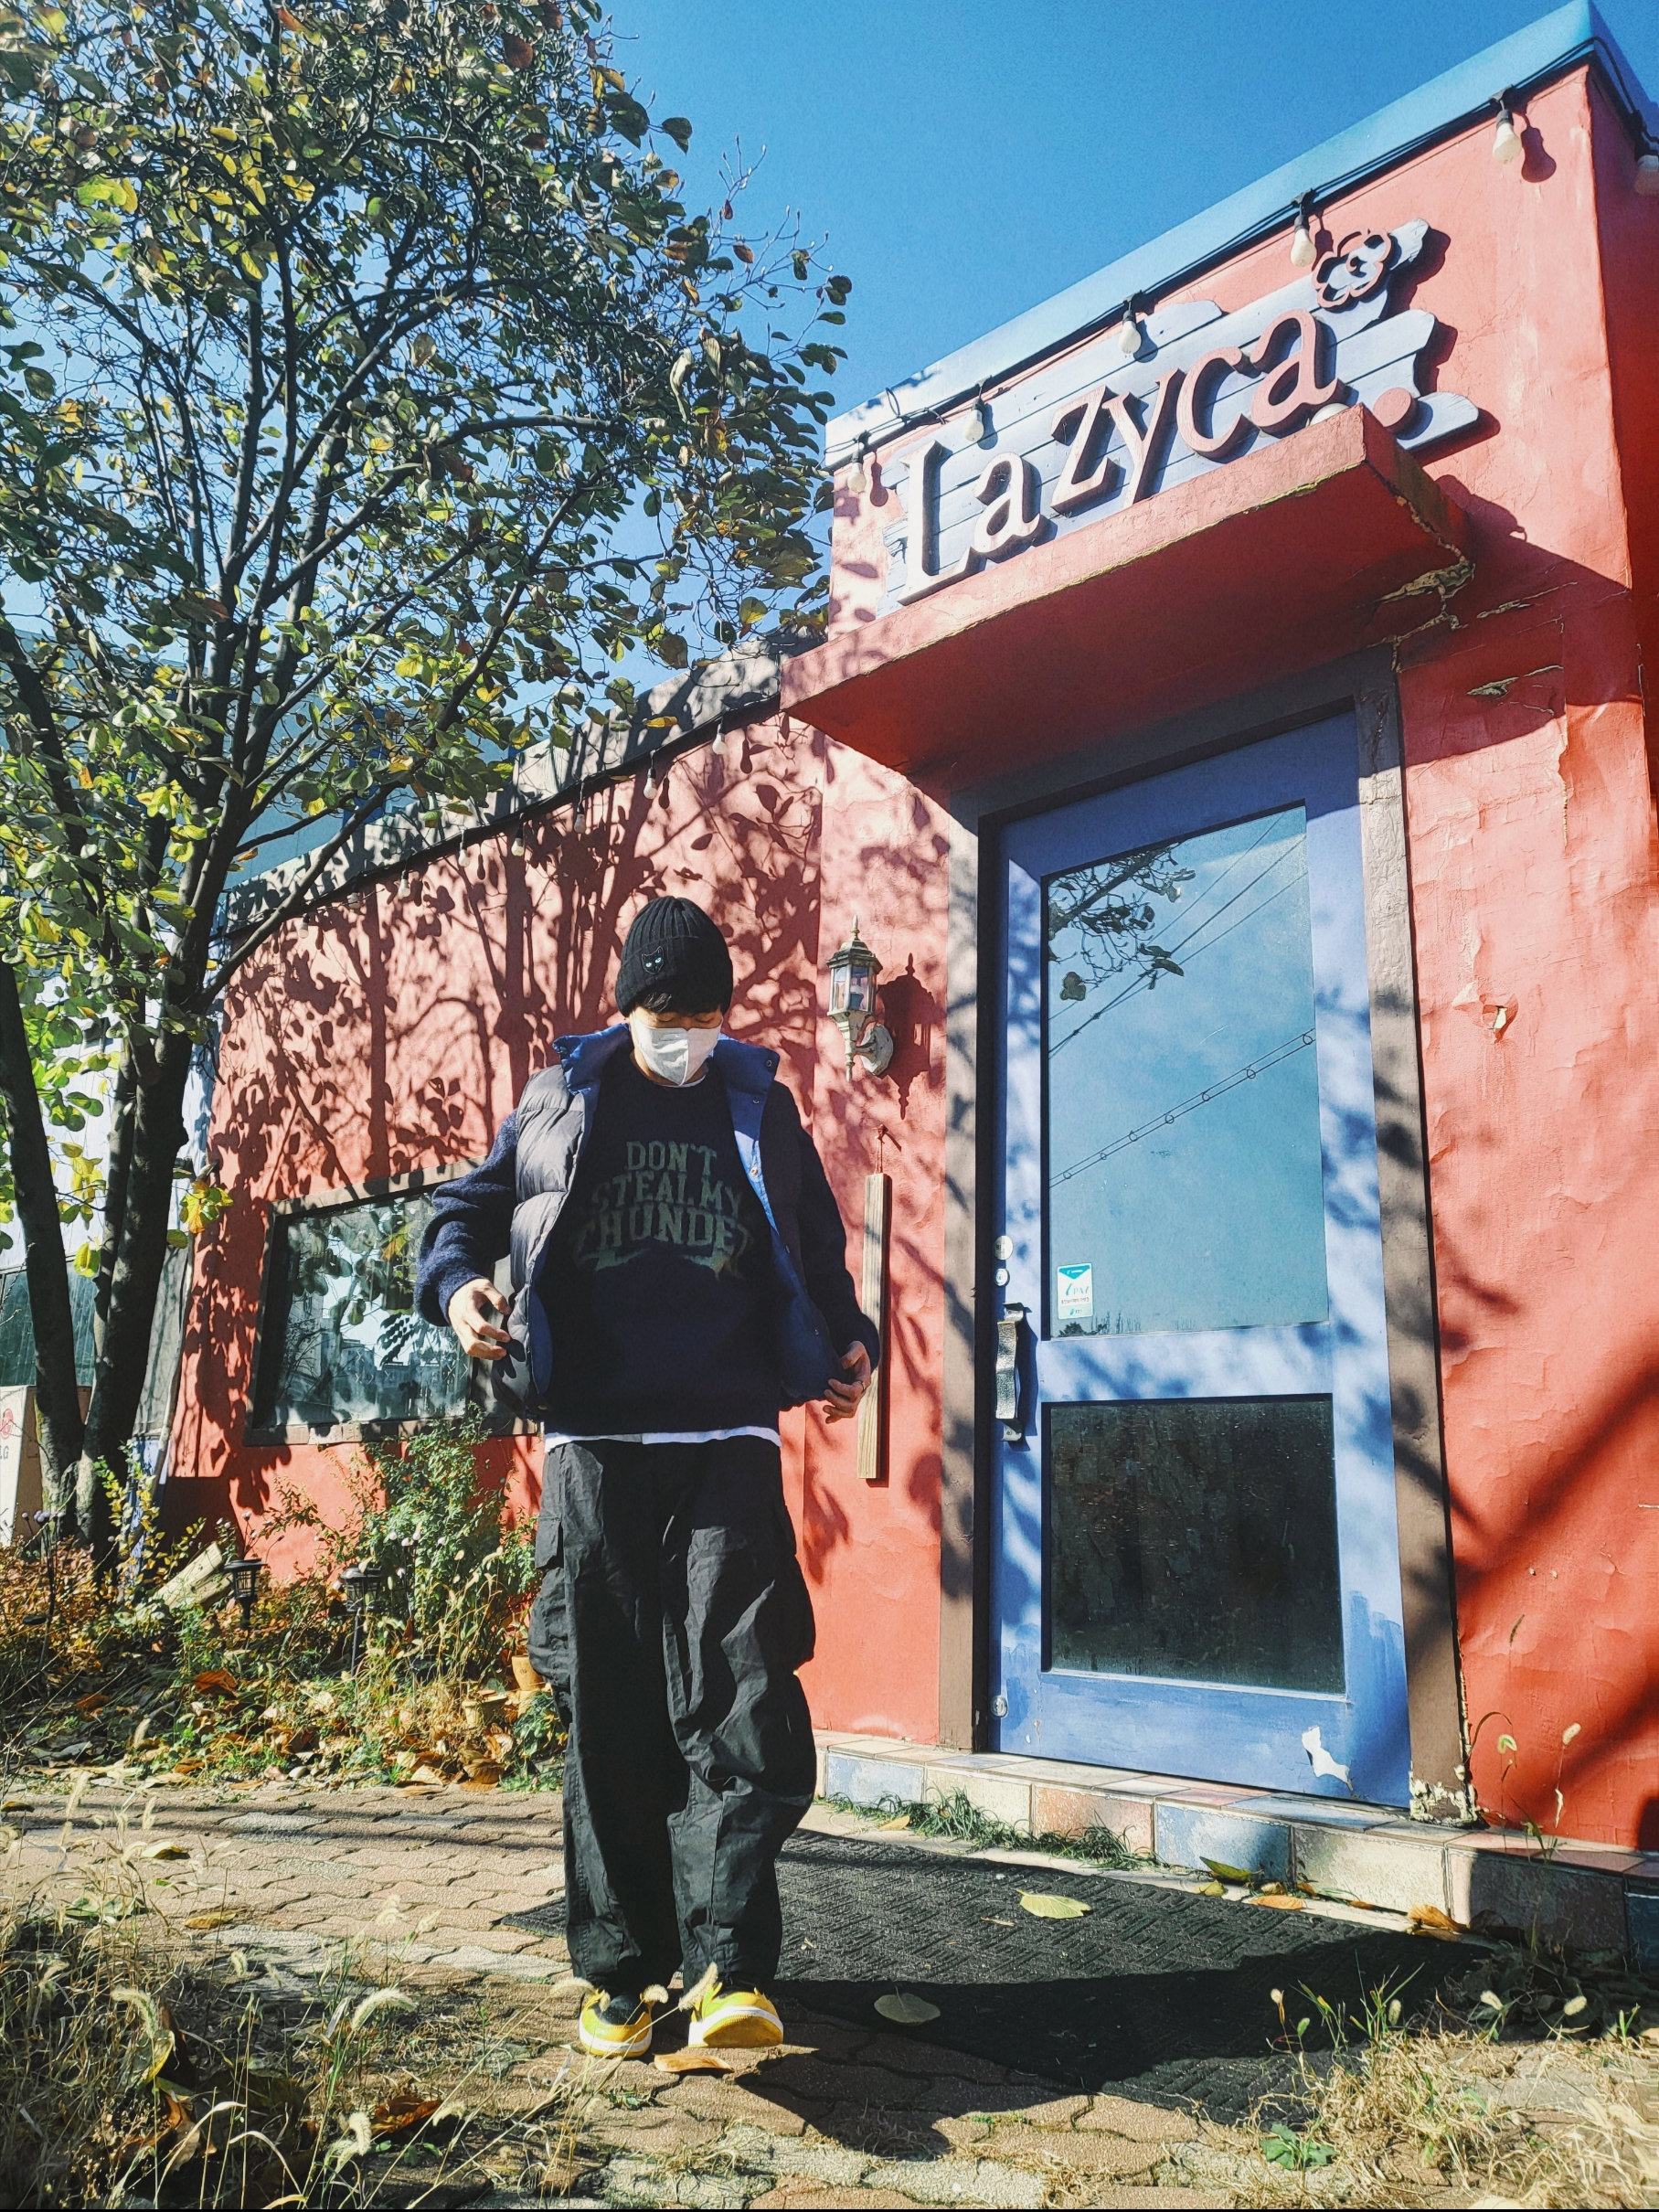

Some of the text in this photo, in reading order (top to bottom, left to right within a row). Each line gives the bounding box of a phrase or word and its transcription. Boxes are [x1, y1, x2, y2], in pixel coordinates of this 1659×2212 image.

[624, 1140, 718, 1176] DON'T
[591, 1169, 742, 1219] STEAL MY
